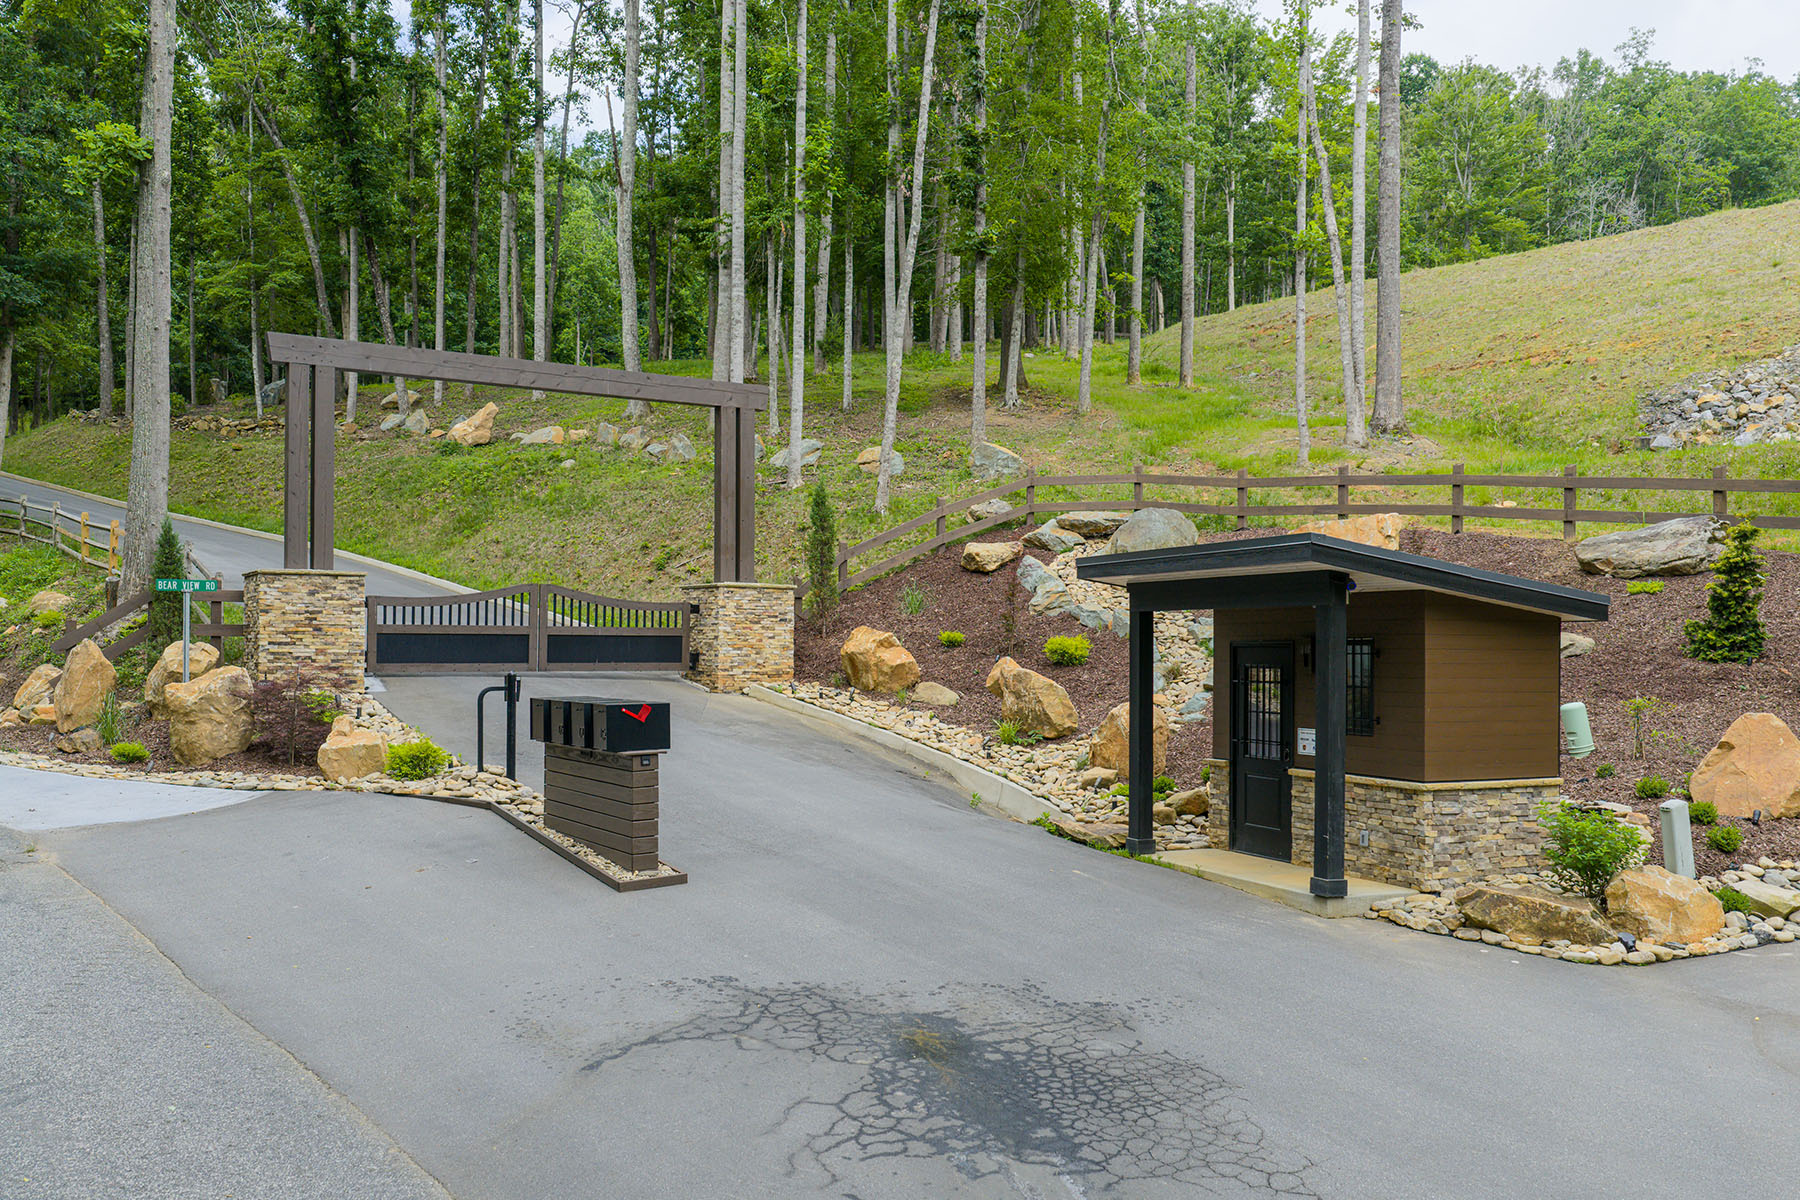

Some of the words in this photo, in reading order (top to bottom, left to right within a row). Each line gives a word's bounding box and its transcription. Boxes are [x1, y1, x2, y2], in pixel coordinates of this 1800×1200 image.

[158, 580, 178, 590] BEAR
[182, 581, 200, 590] VIEW
[205, 581, 216, 591] RD
